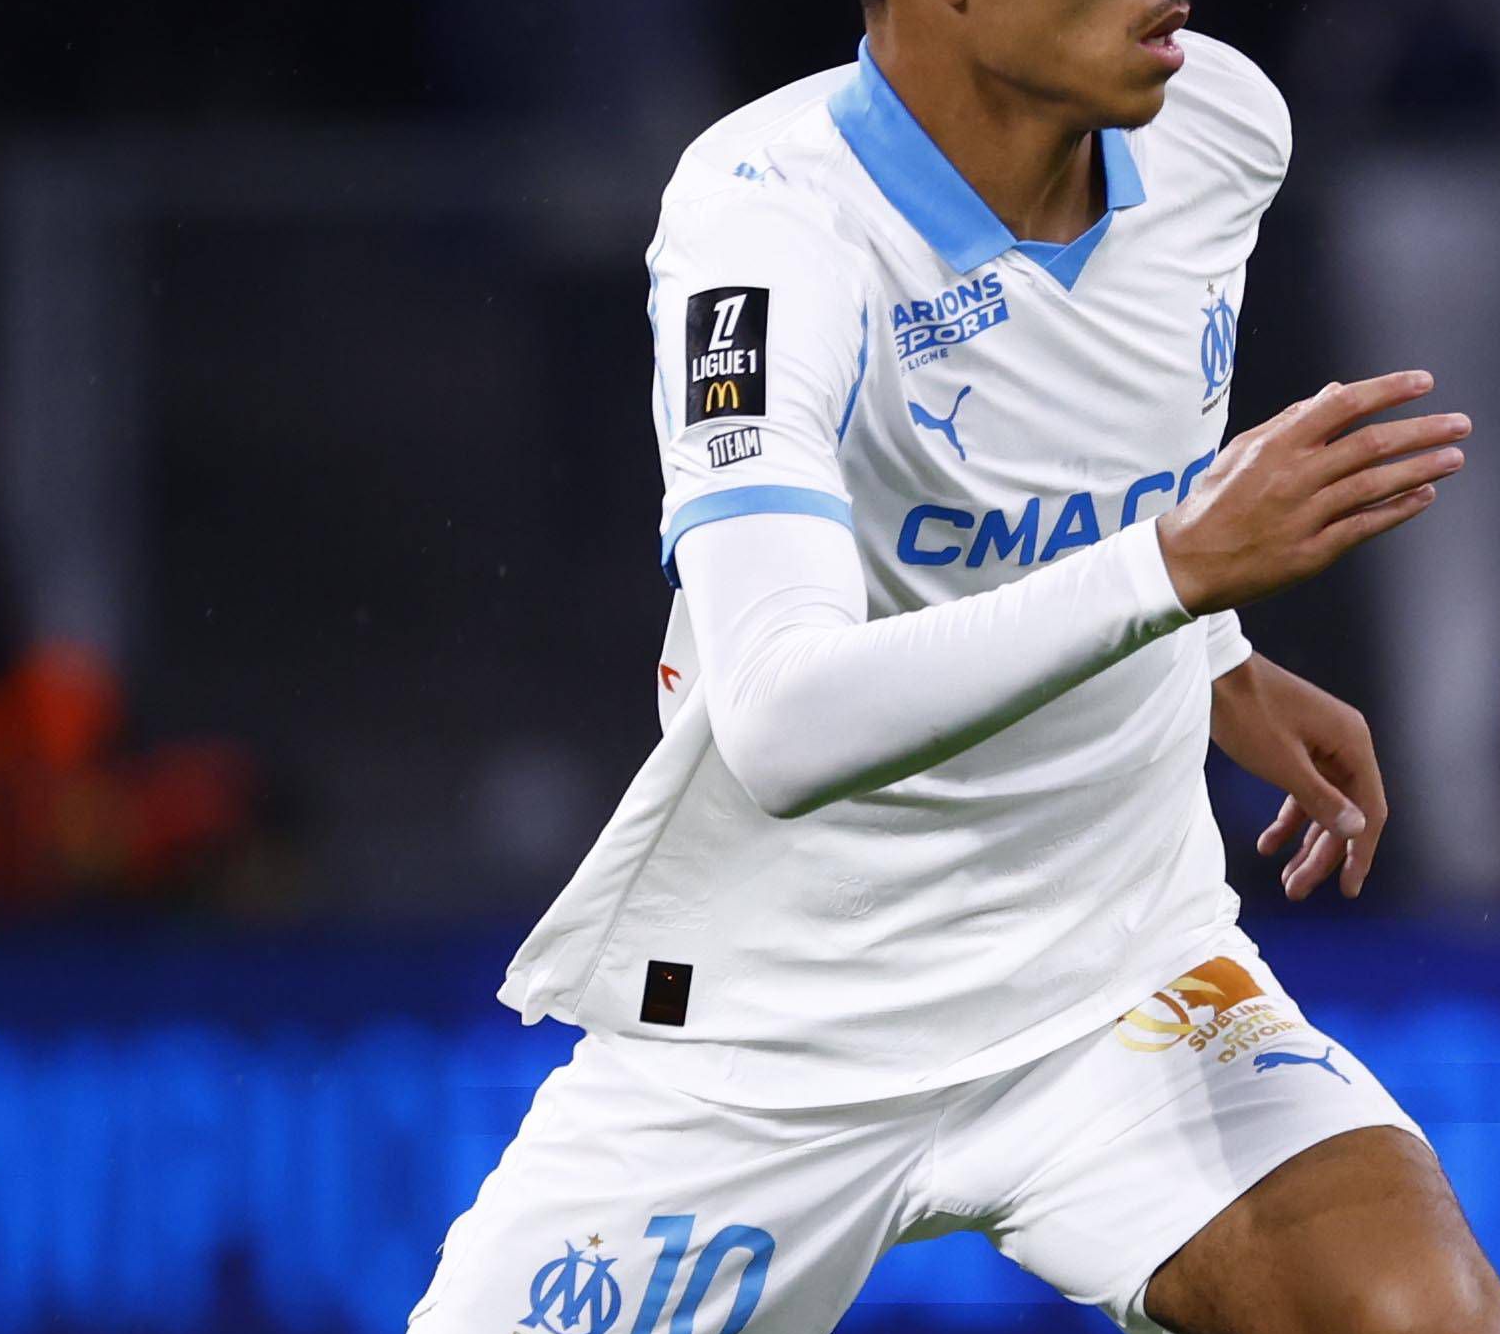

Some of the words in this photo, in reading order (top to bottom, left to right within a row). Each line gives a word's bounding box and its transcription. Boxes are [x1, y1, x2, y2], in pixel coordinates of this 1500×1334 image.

[889, 272, 1003, 331] ARIONS
[692, 350, 745, 383] LIGUE
[747, 349, 757, 374] 1
[897, 491, 1102, 567] CMA
